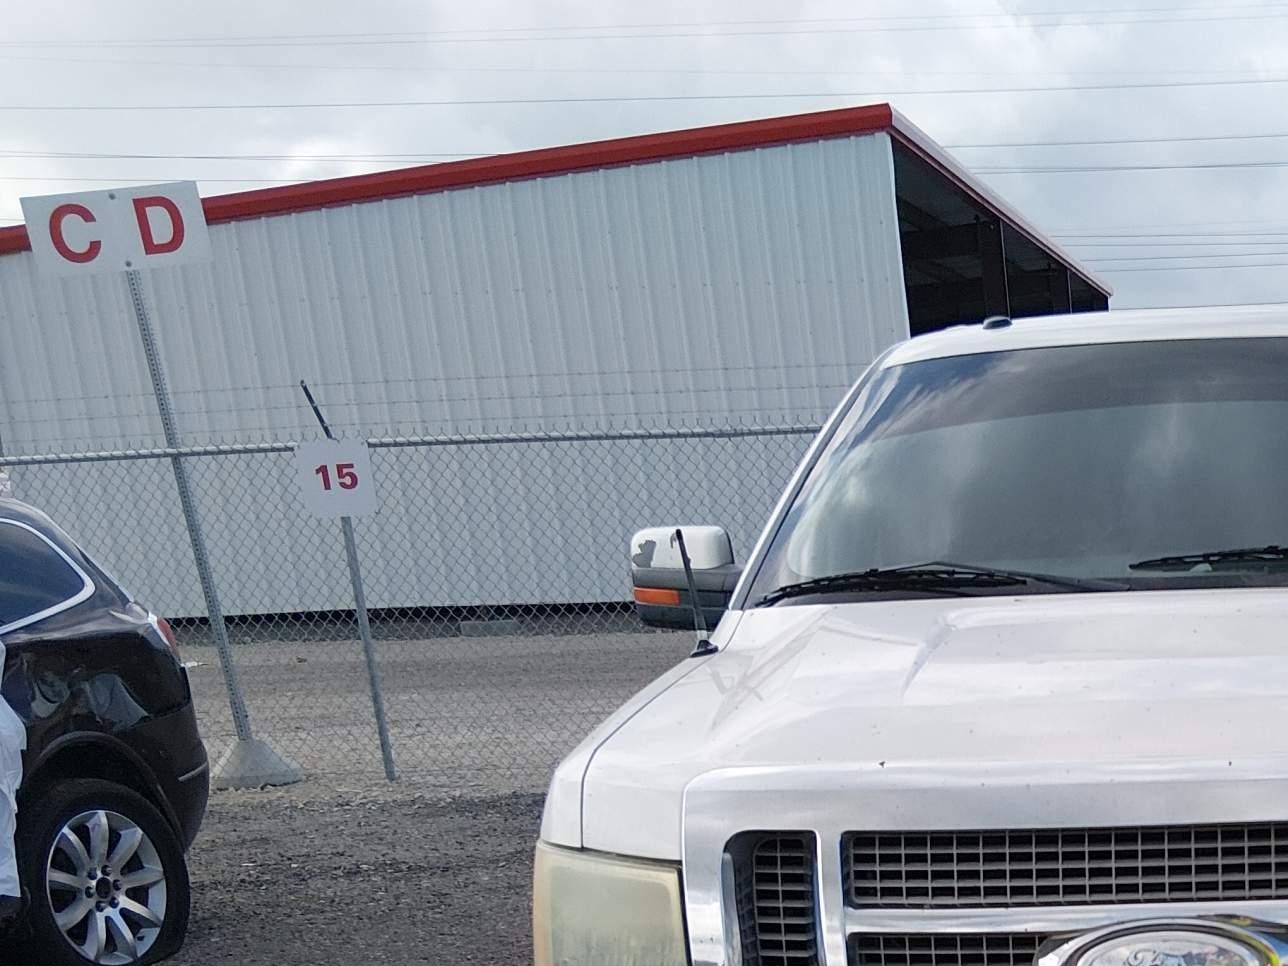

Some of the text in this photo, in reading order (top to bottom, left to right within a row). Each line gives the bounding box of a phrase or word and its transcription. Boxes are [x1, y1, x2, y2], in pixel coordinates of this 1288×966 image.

[49, 195, 185, 264] C D
[315, 463, 358, 491] 15
